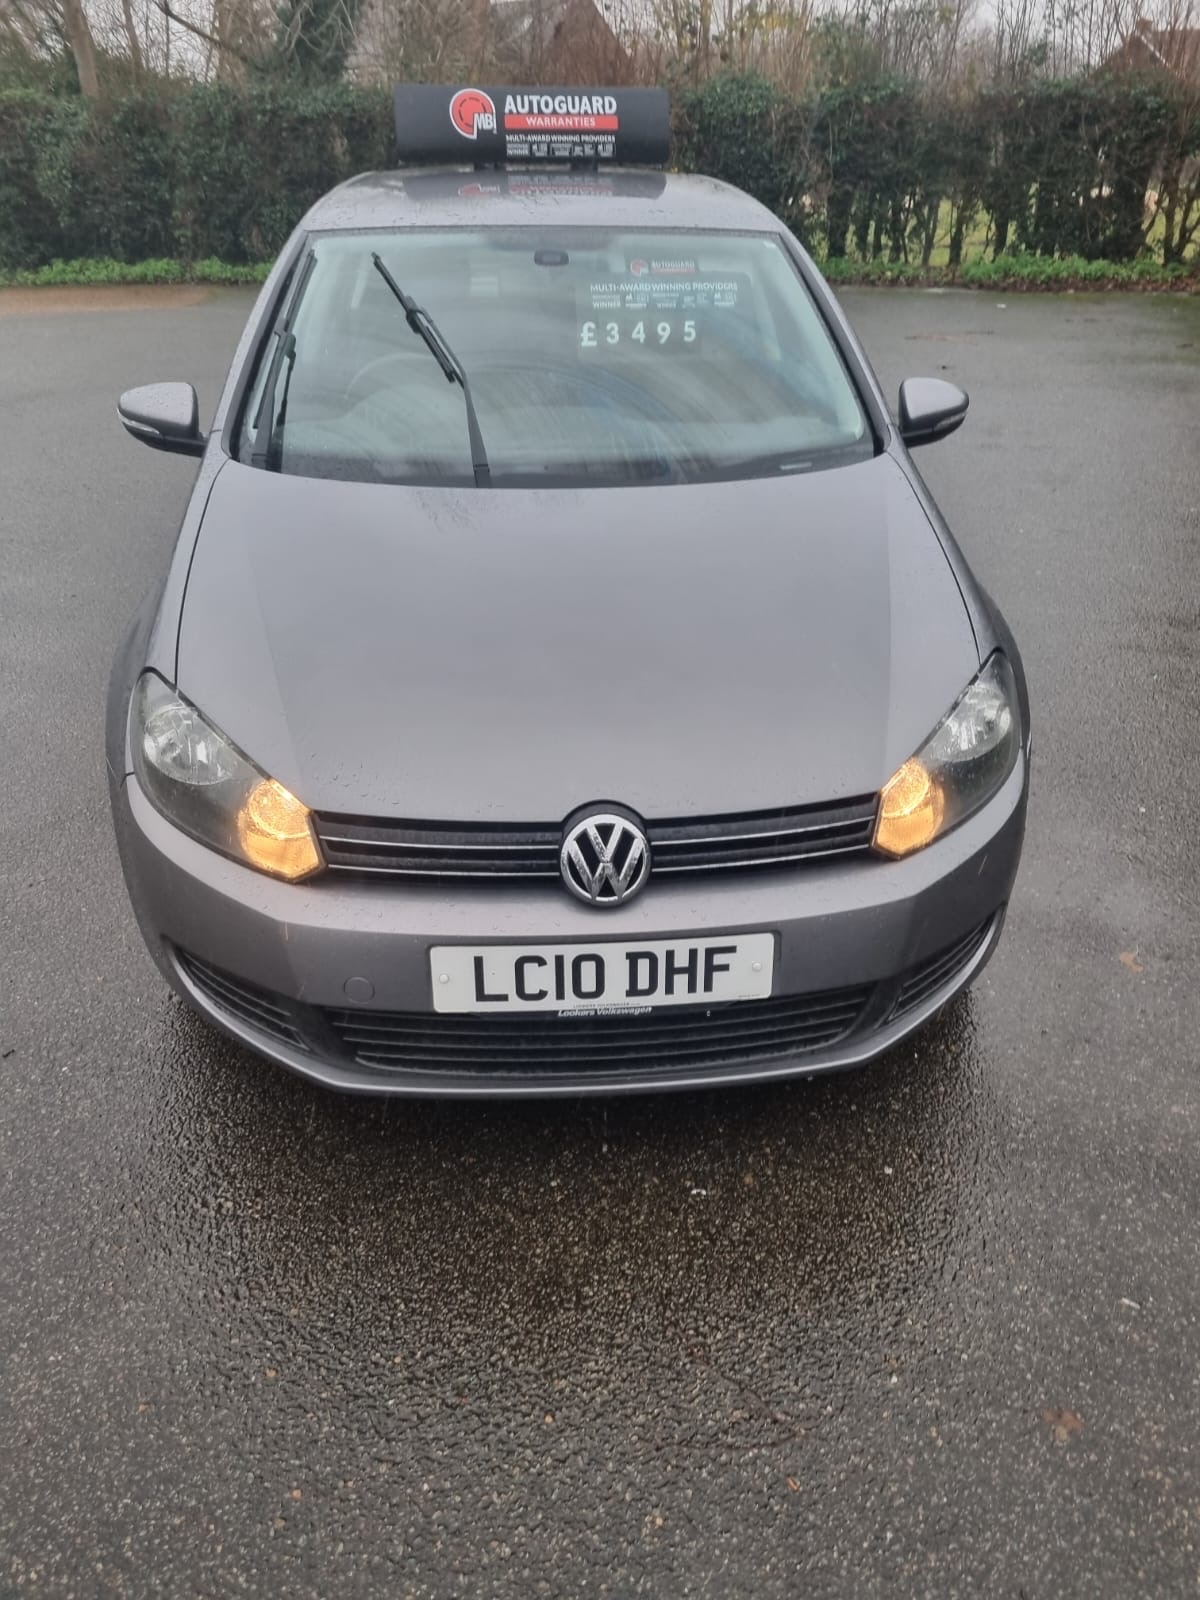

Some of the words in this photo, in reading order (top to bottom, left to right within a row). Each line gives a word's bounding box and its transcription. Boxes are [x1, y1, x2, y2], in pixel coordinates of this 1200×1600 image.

[504, 94, 617, 115] AUTOGUARD
[526, 116, 596, 127] WARRANTIES
[551, 134, 580, 143] WINNING
[581, 134, 616, 143] PROVIDERS
[590, 283, 651, 293] MULTI-AWARD
[651, 283, 691, 292] WINNING
[692, 282, 738, 291] PROVIDERS
[473, 953, 606, 1003] LC10
[625, 945, 738, 998] DHF
[557, 1009, 595, 1017] Lookers
[596, 1006, 653, 1016] Volkswagen
